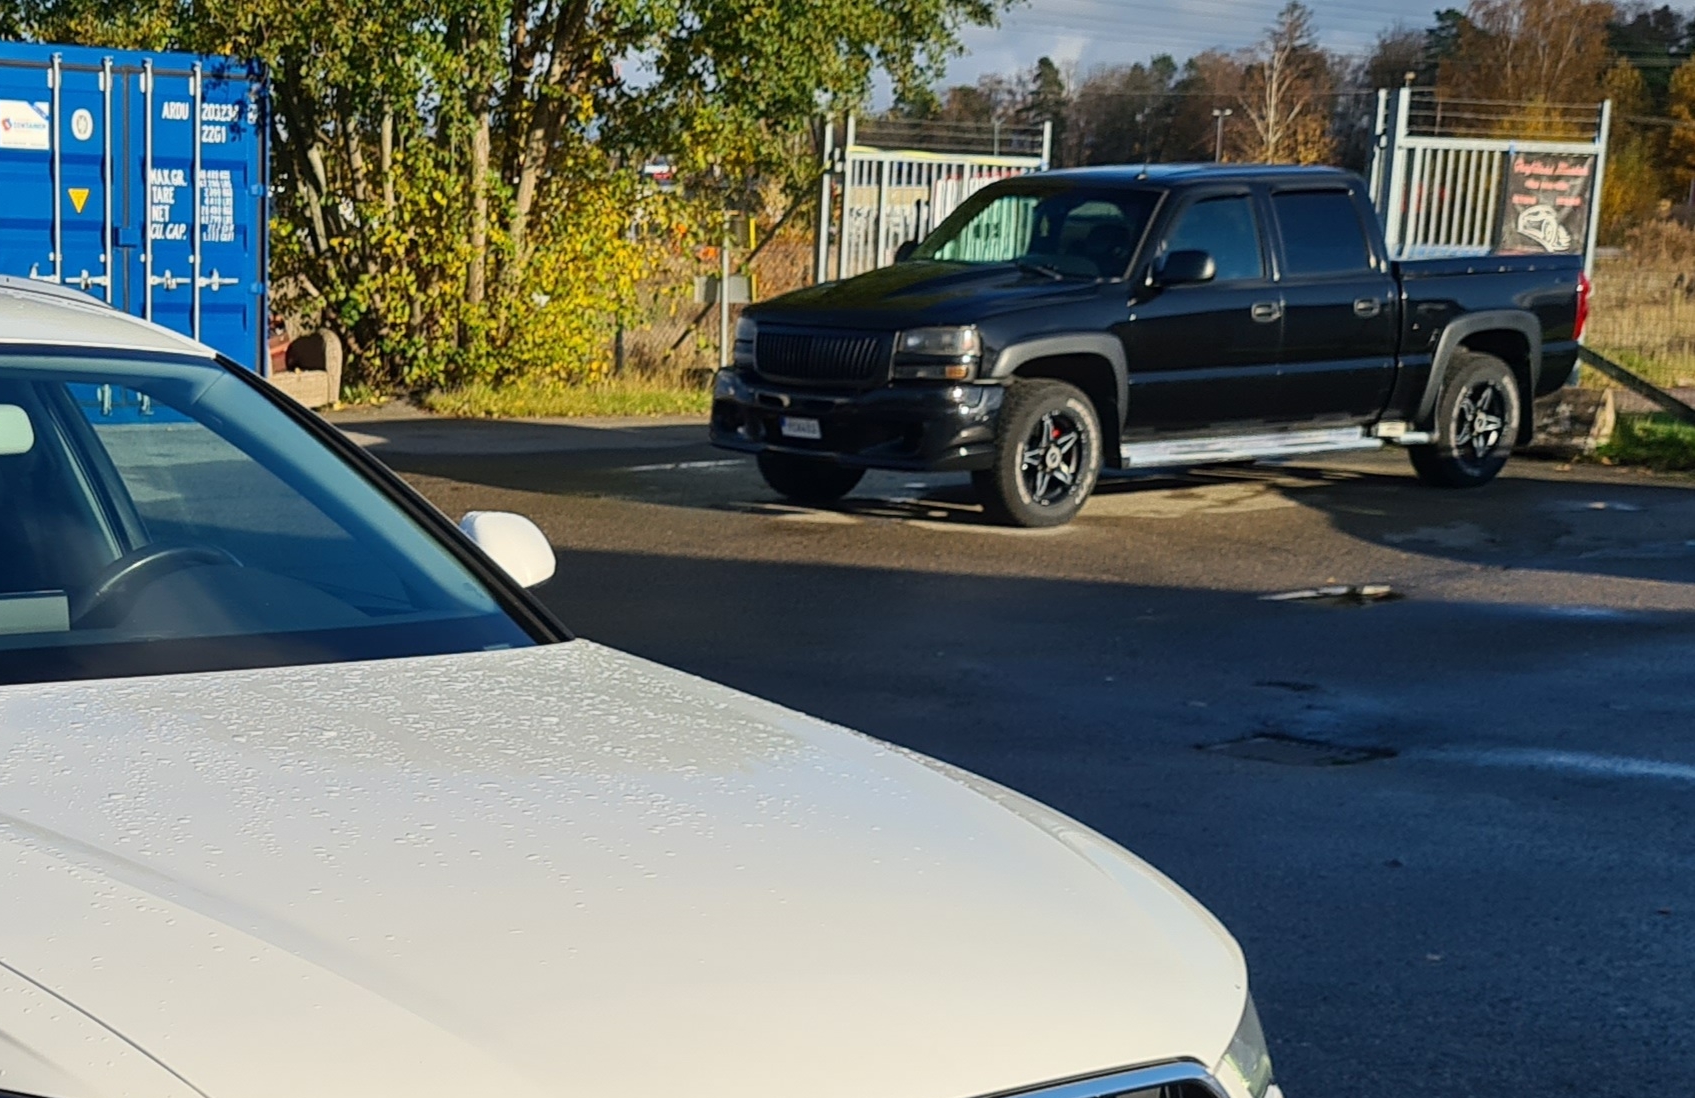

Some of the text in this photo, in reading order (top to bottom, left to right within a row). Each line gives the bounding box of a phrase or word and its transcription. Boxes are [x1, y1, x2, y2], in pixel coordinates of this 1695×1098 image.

[161, 102, 190, 120] ARDU
[202, 125, 226, 143] 22G1
[152, 186, 176, 204] TARE
[152, 205, 170, 222] NET
